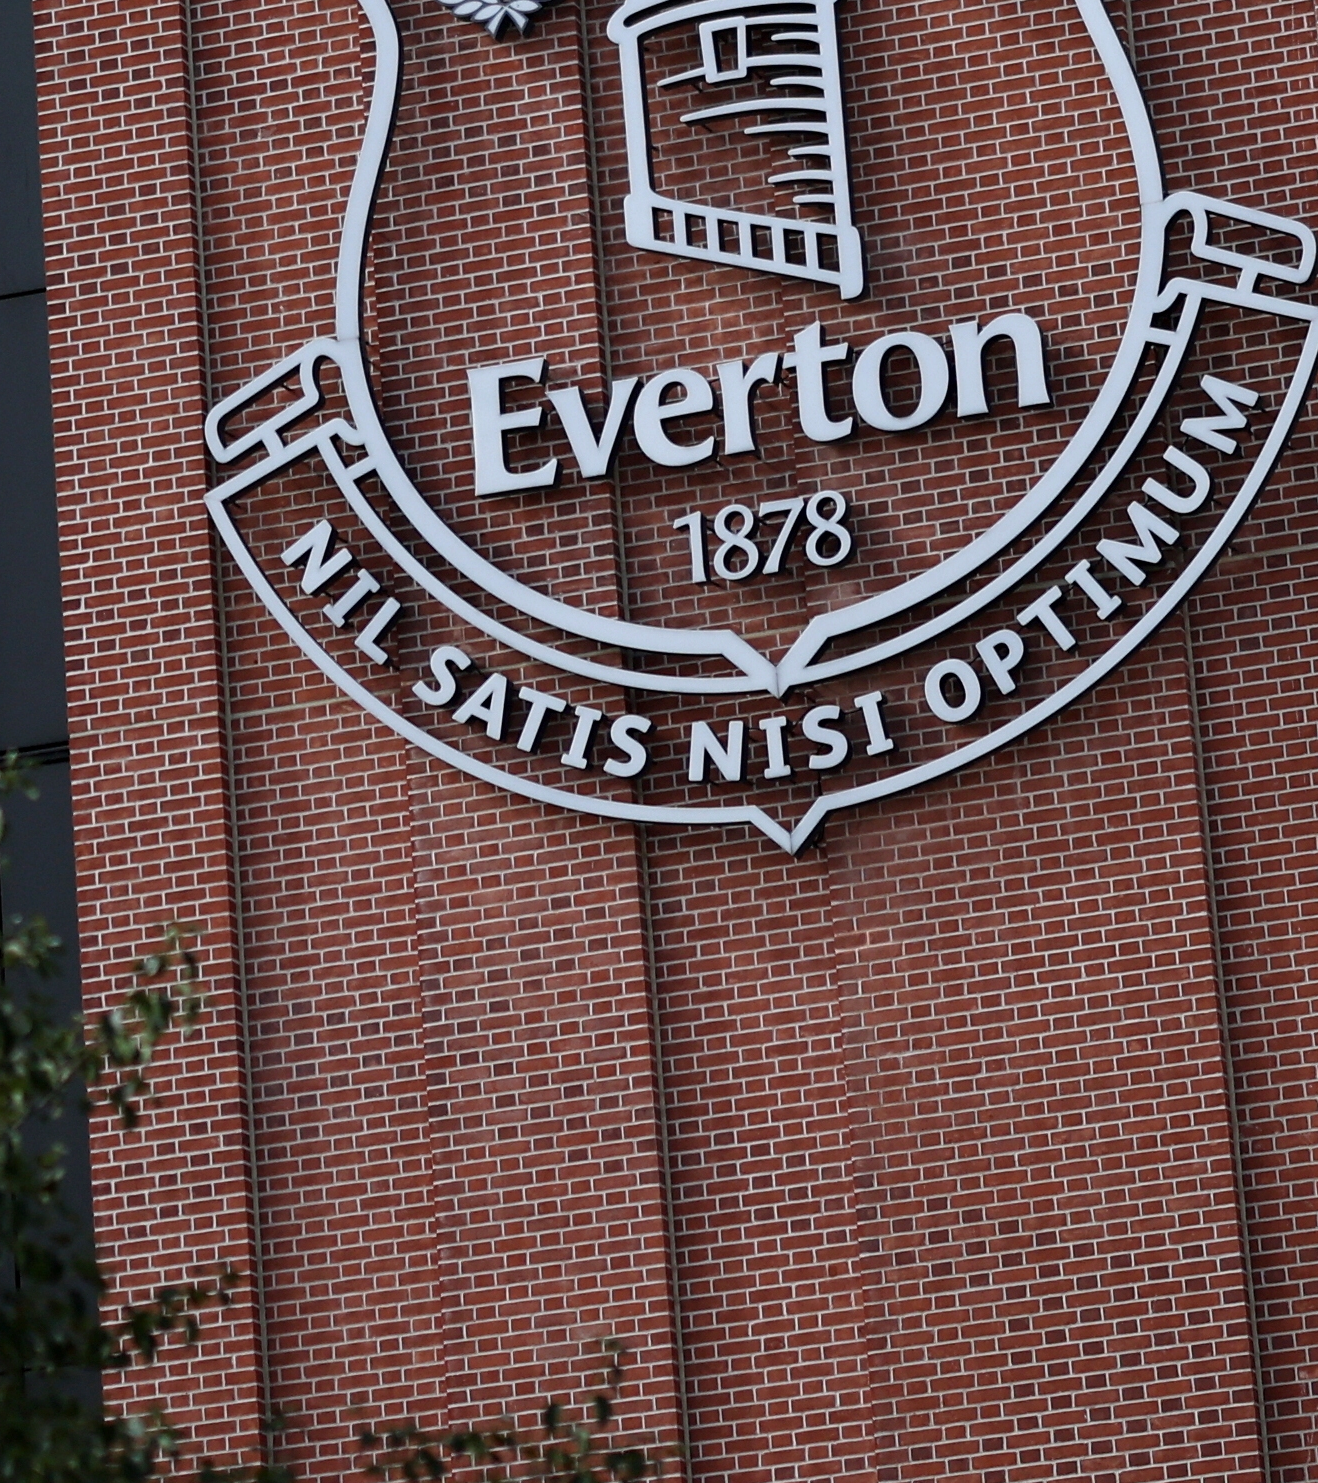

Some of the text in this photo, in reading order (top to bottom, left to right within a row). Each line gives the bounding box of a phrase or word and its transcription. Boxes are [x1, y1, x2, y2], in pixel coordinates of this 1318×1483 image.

[467, 313, 1052, 496] Everton
[281, 374, 1260, 783] NIL SATIS NISI OPTIMUM
[673, 490, 851, 583] 1878
